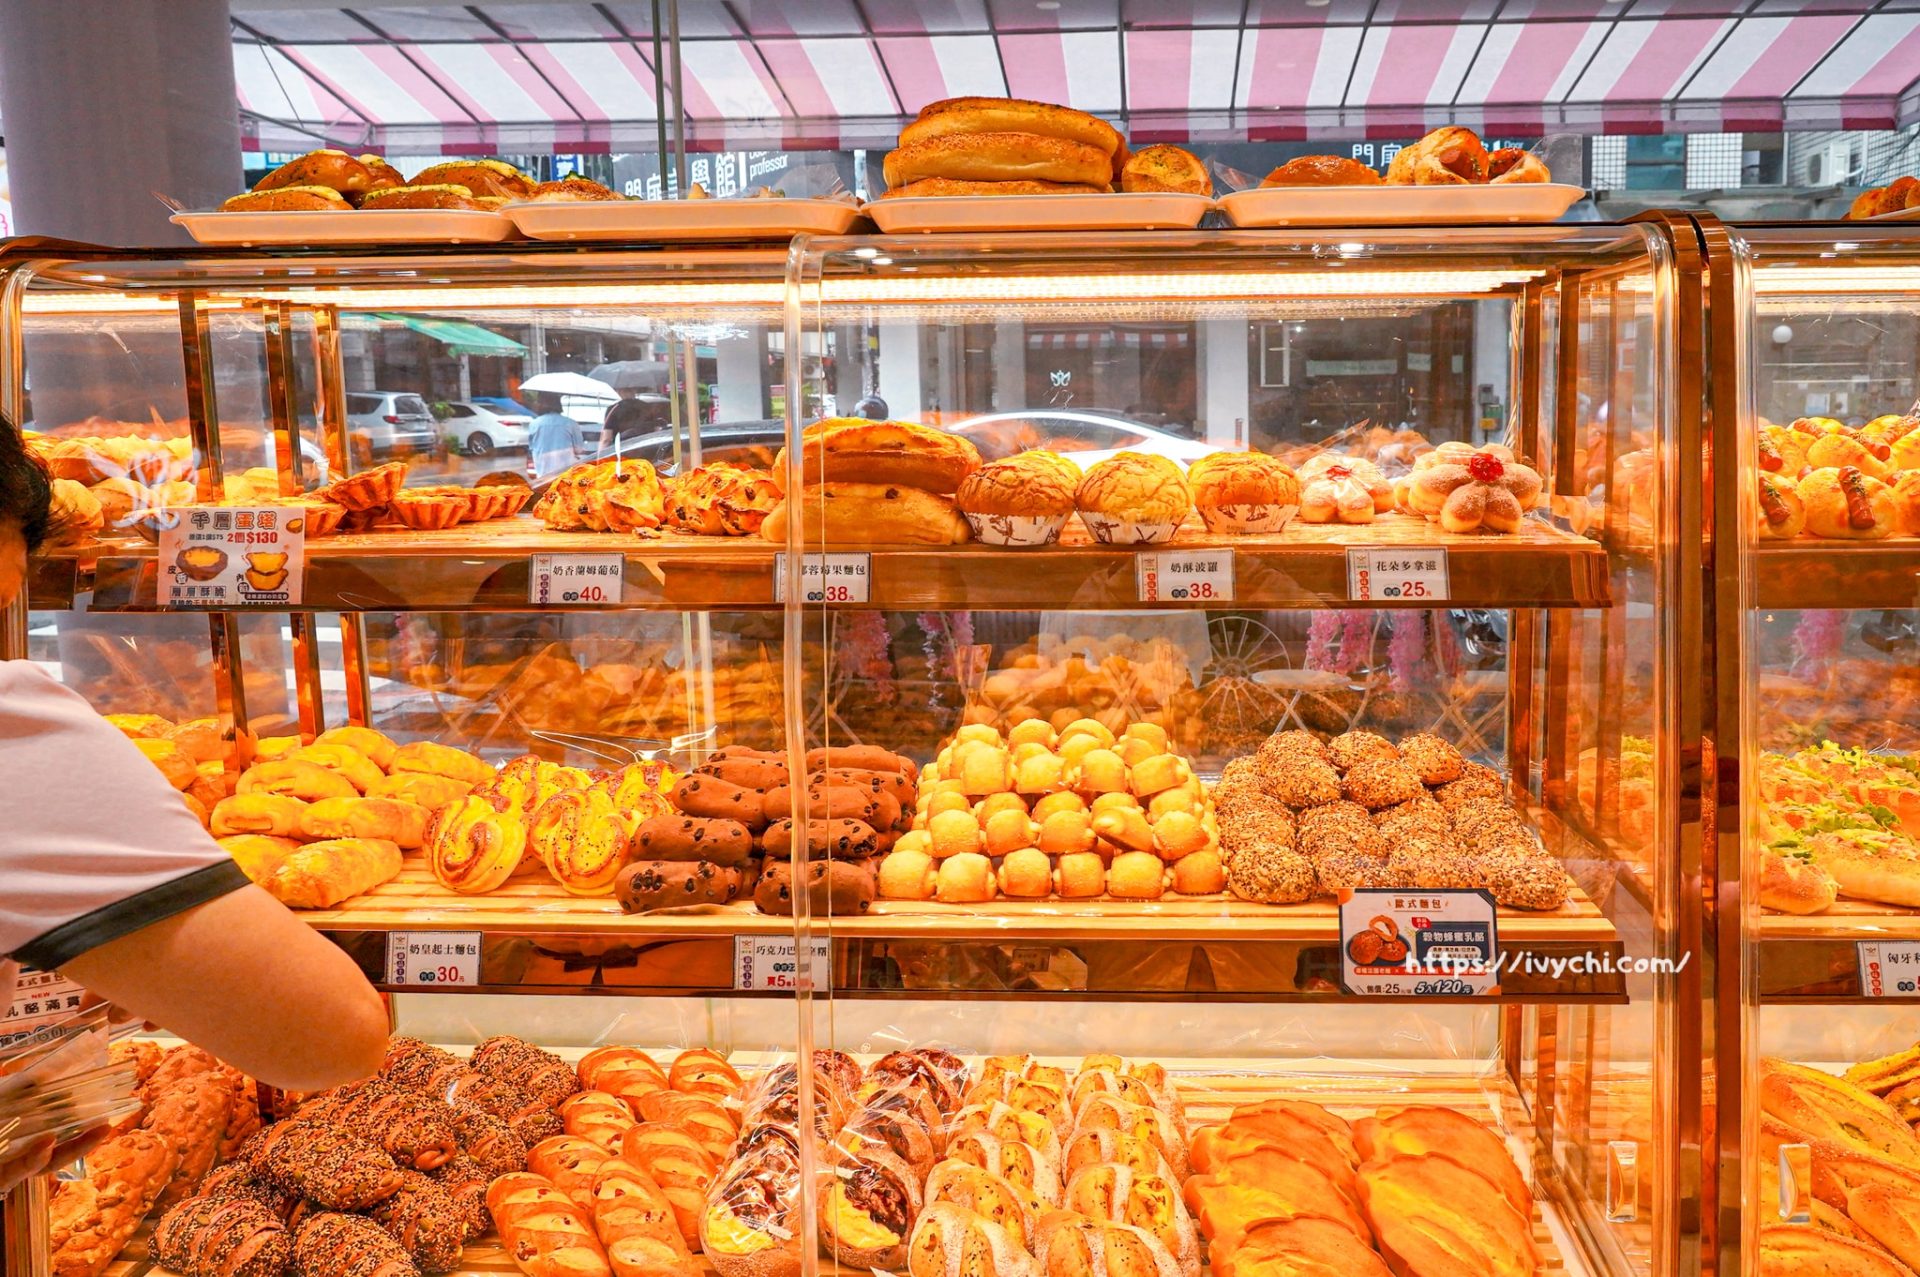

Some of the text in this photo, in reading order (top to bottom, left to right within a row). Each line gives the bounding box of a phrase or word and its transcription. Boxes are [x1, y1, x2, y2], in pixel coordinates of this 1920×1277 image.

[749, 154, 789, 182] professor
[191, 511, 277, 530] 千層蛋塔
[553, 565, 619, 576] 奶香蘭姆葡萄
[1170, 561, 1218, 573] 奶酥波羅
[1377, 561, 1437, 571] 花朵多拿滋
[1422, 931, 1485, 942] 穀物蜂蜜乳酪
[409, 943, 476, 955] 奶皇起士麵包
